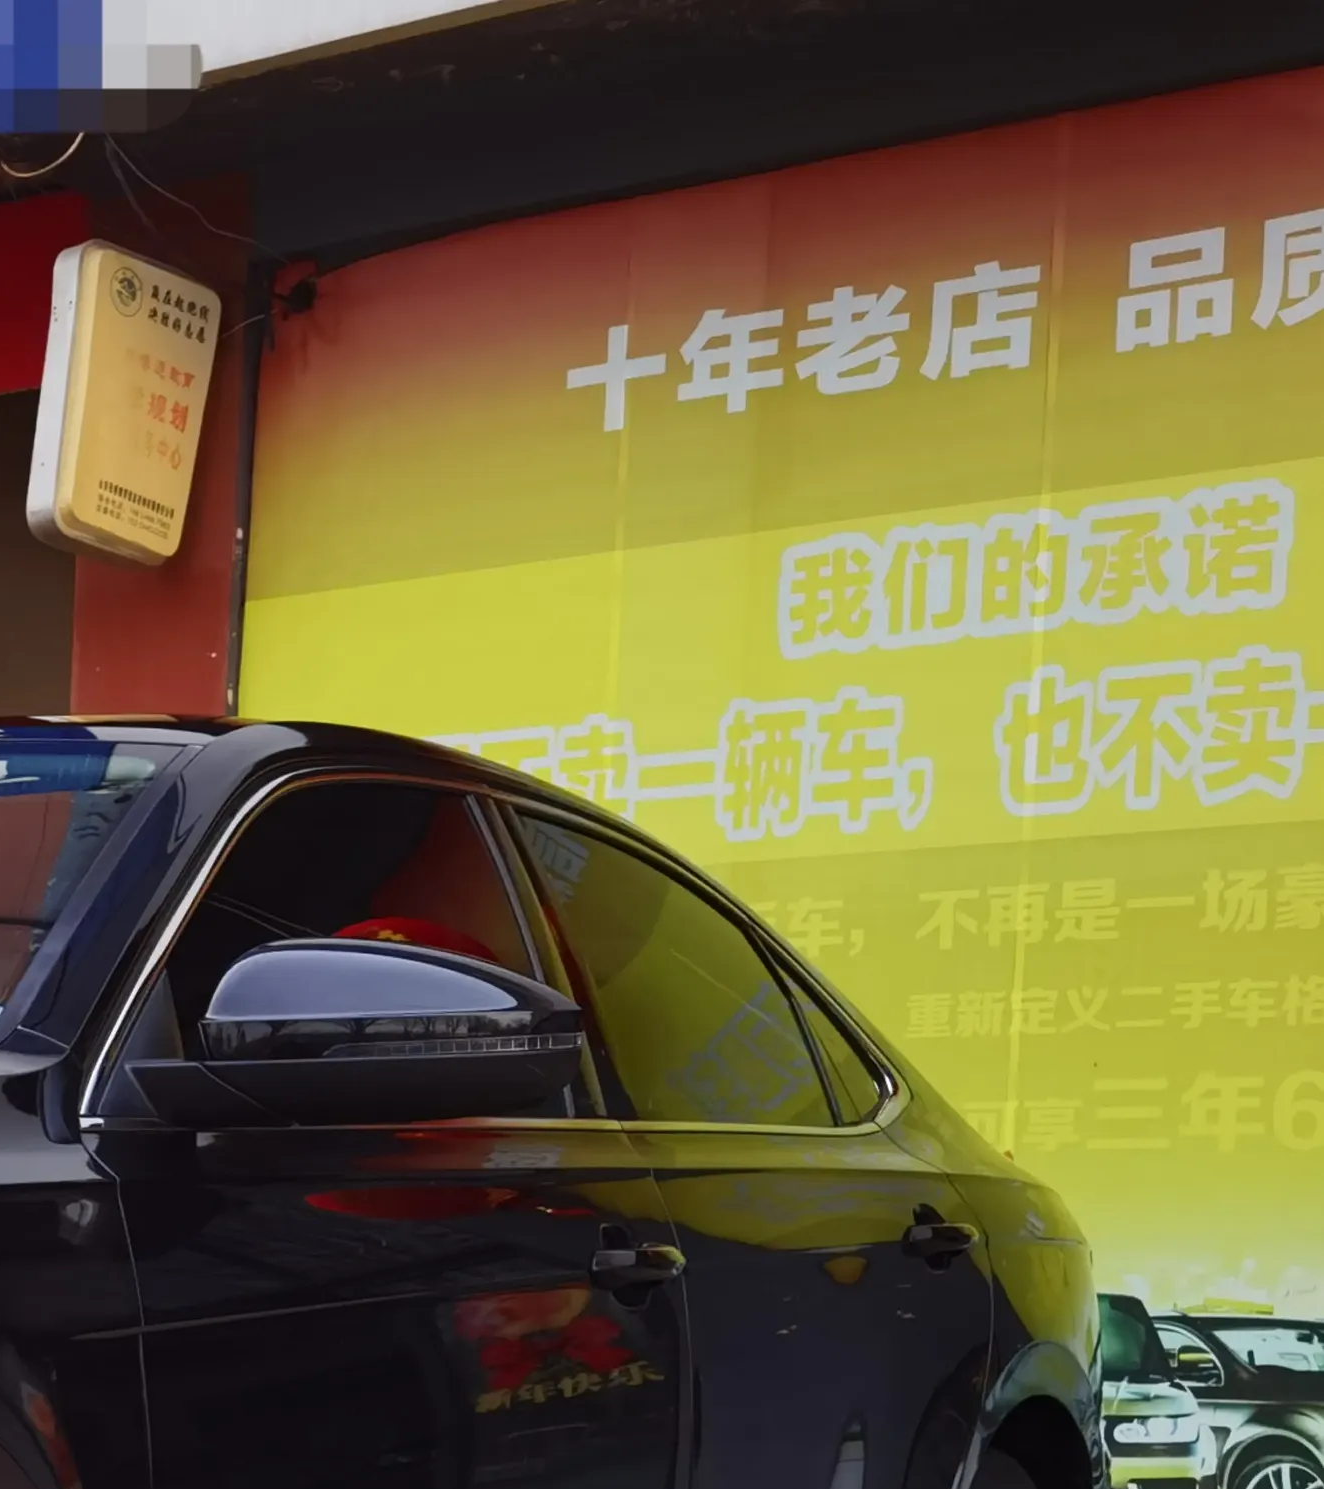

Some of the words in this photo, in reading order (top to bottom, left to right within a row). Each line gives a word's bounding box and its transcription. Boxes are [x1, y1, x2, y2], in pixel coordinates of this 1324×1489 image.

[565, 259, 1042, 433] 十年老店
[777, 478, 1295, 660] 我们的承诺
[905, 973, 1324, 1038] 重新定义二手车格
